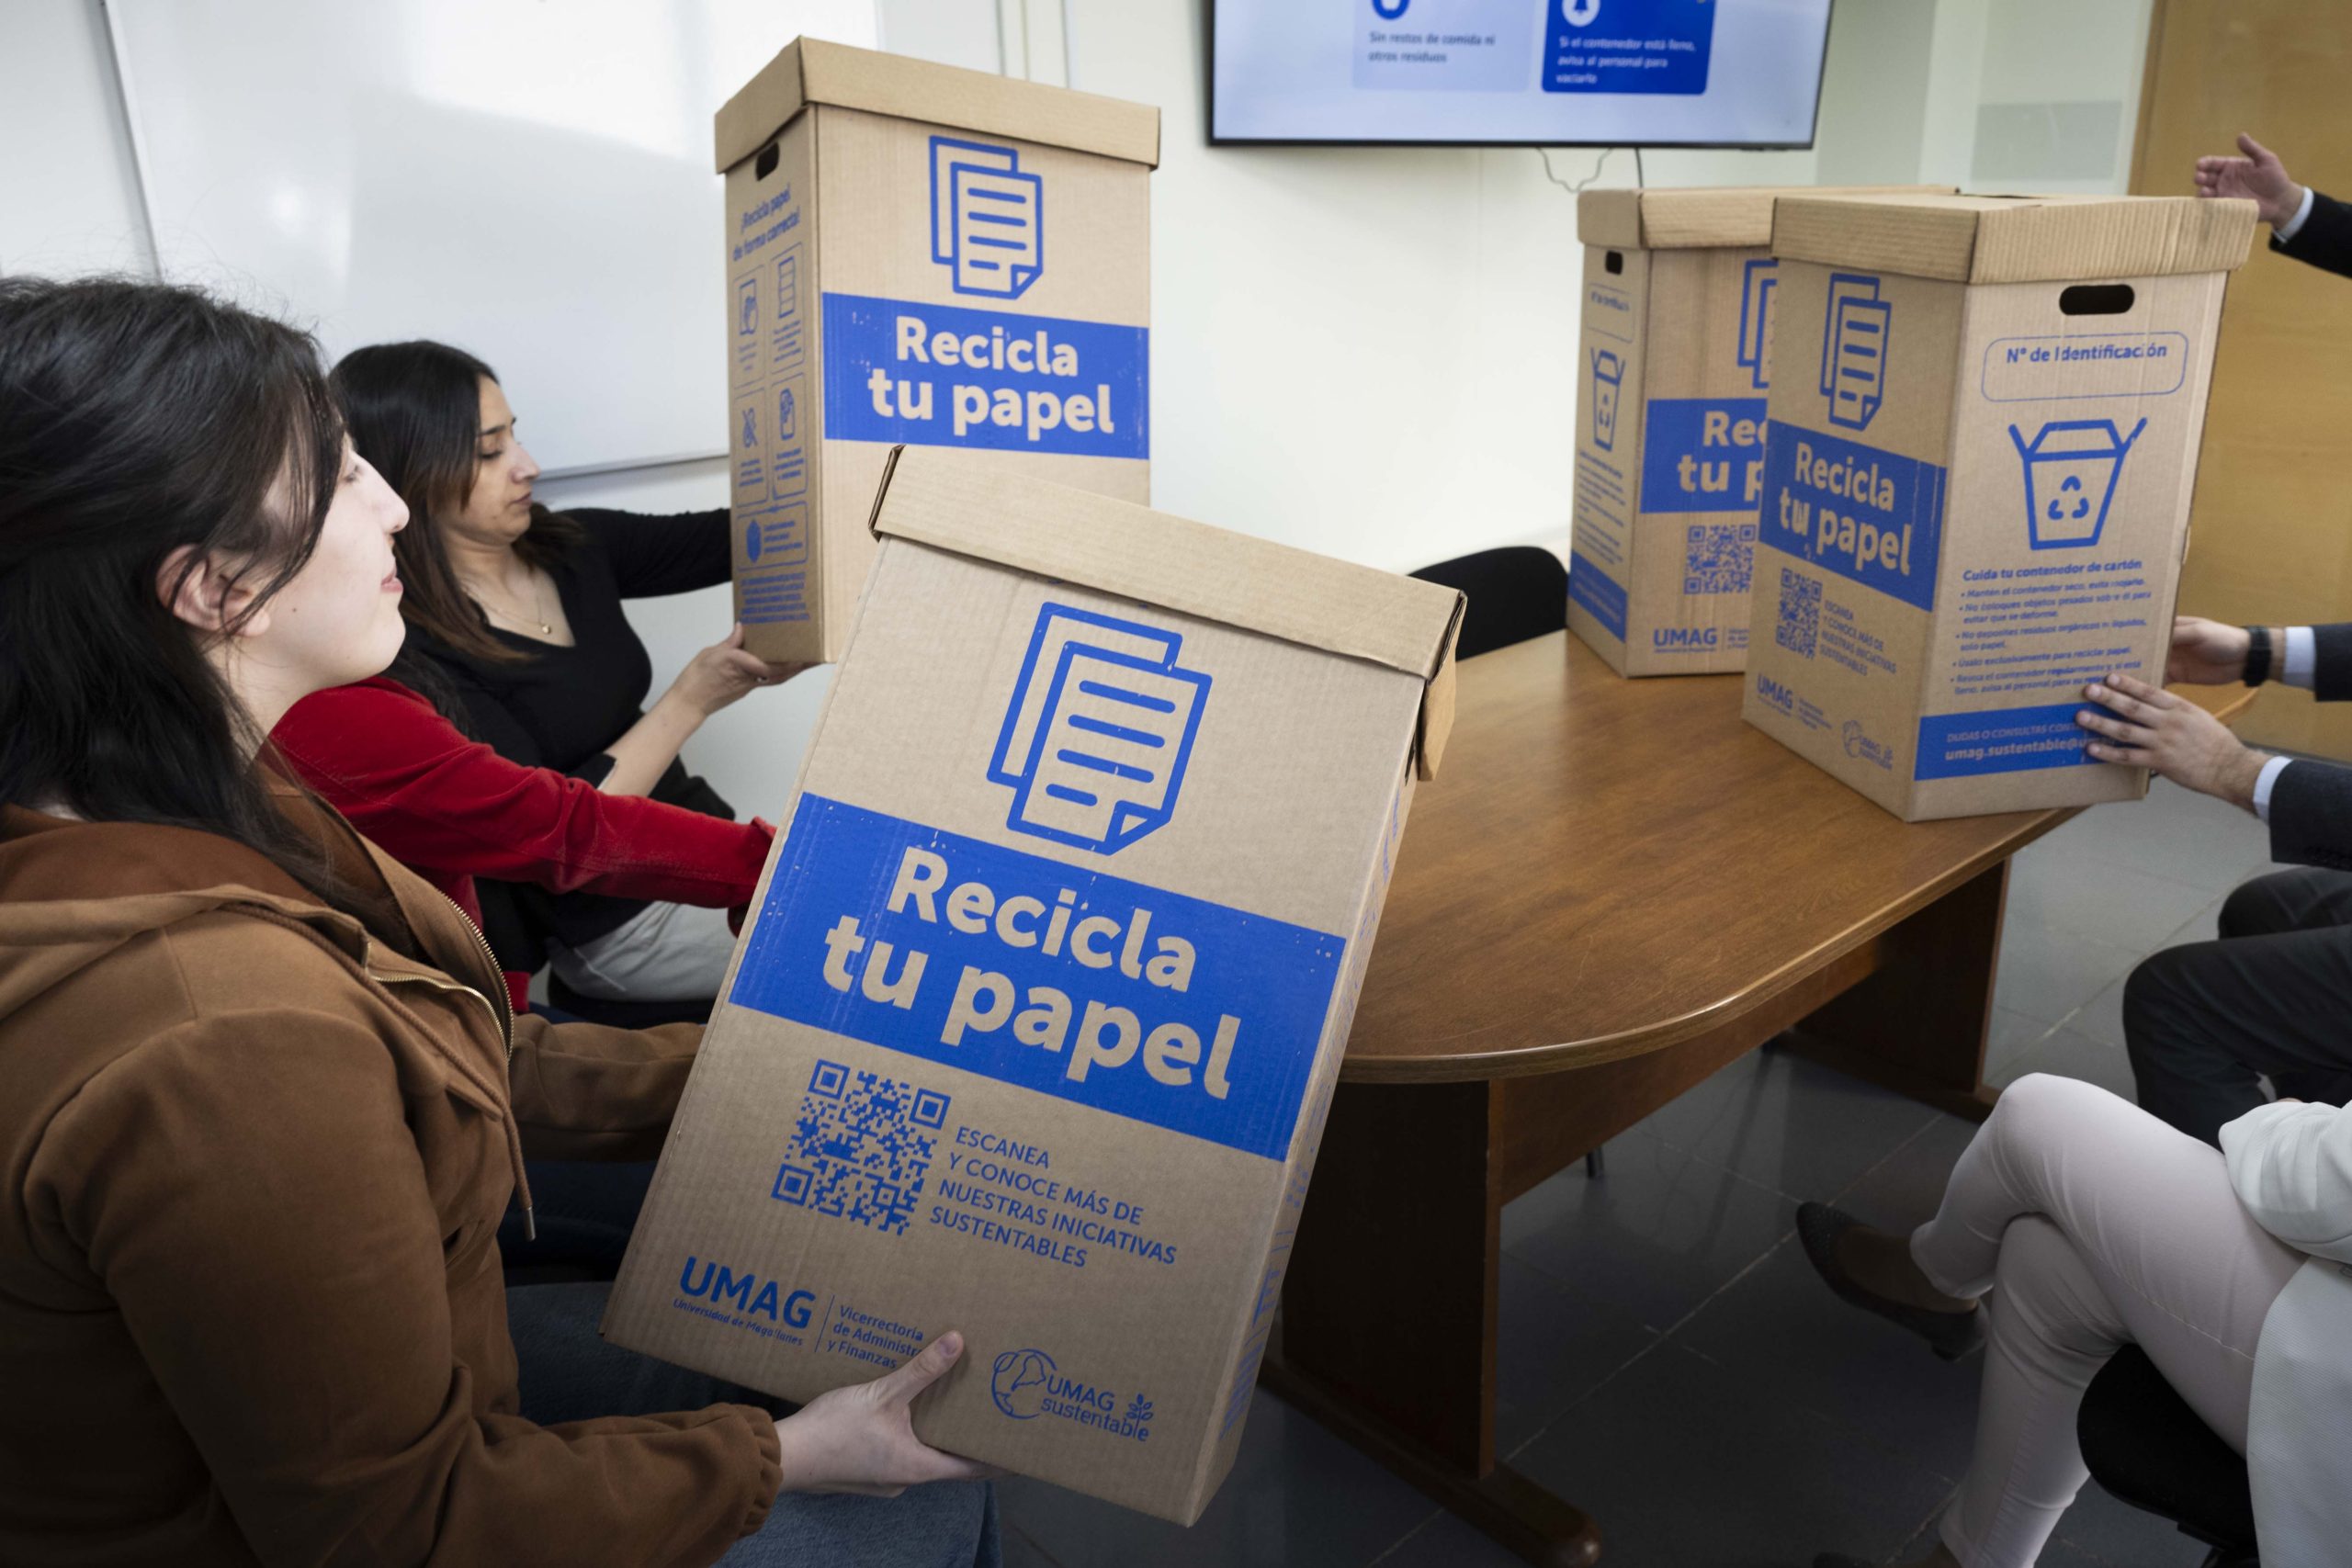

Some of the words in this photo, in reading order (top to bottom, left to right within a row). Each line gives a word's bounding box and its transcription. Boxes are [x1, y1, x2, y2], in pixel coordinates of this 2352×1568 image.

[1426, 33, 1439, 44] de
[896, 315, 1079, 377] Recicla
[2030, 347, 2051, 362] de
[867, 368, 933, 420] tu
[953, 384, 1114, 441] papel
[1677, 455, 1730, 492] tu
[1794, 442, 1894, 513] Recicla
[1780, 487, 1810, 536] tu
[1816, 508, 1912, 577] papel
[1962, 569, 1998, 581] Cuida
[2001, 568, 2014, 579] tu
[2016, 563, 2085, 578] contenedor
[2086, 561, 2102, 572] de
[2104, 559, 2143, 571] cartón
[2012, 584, 2063, 595] contenedor
[1654, 627, 1718, 647] UMAG
[1757, 672, 1793, 709] UMAG
[886, 845, 1197, 993] Recicla
[823, 915, 929, 1010] tu
[940, 965, 1241, 1100] papel
[956, 1126, 1050, 1169] ESCANEA
[950, 1152, 963, 1170] Y
[966, 1158, 1060, 1201] CONOCE
[1063, 1186, 1110, 1215] MÁS
[1114, 1201, 1144, 1225] DE
[930, 1205, 1088, 1268] SUSTENTABLES
[938, 1179, 1048, 1226] NUESTRAS
[1052, 1213, 1177, 1265] INICIATIVAS
[679, 1256, 816, 1329] UMAG
[673, 1298, 730, 1325] Universidad
[732, 1314, 744, 1328] de
[840, 1304, 923, 1342] Vicerrectoría
[827, 1339, 836, 1353] y
[838, 1343, 898, 1370] Finanzas
[833, 1321, 850, 1337] de
[852, 1325, 922, 1359] Administr
[1047, 1374, 1115, 1412] UMAG
[1041, 1396, 1149, 1442] sustentable
